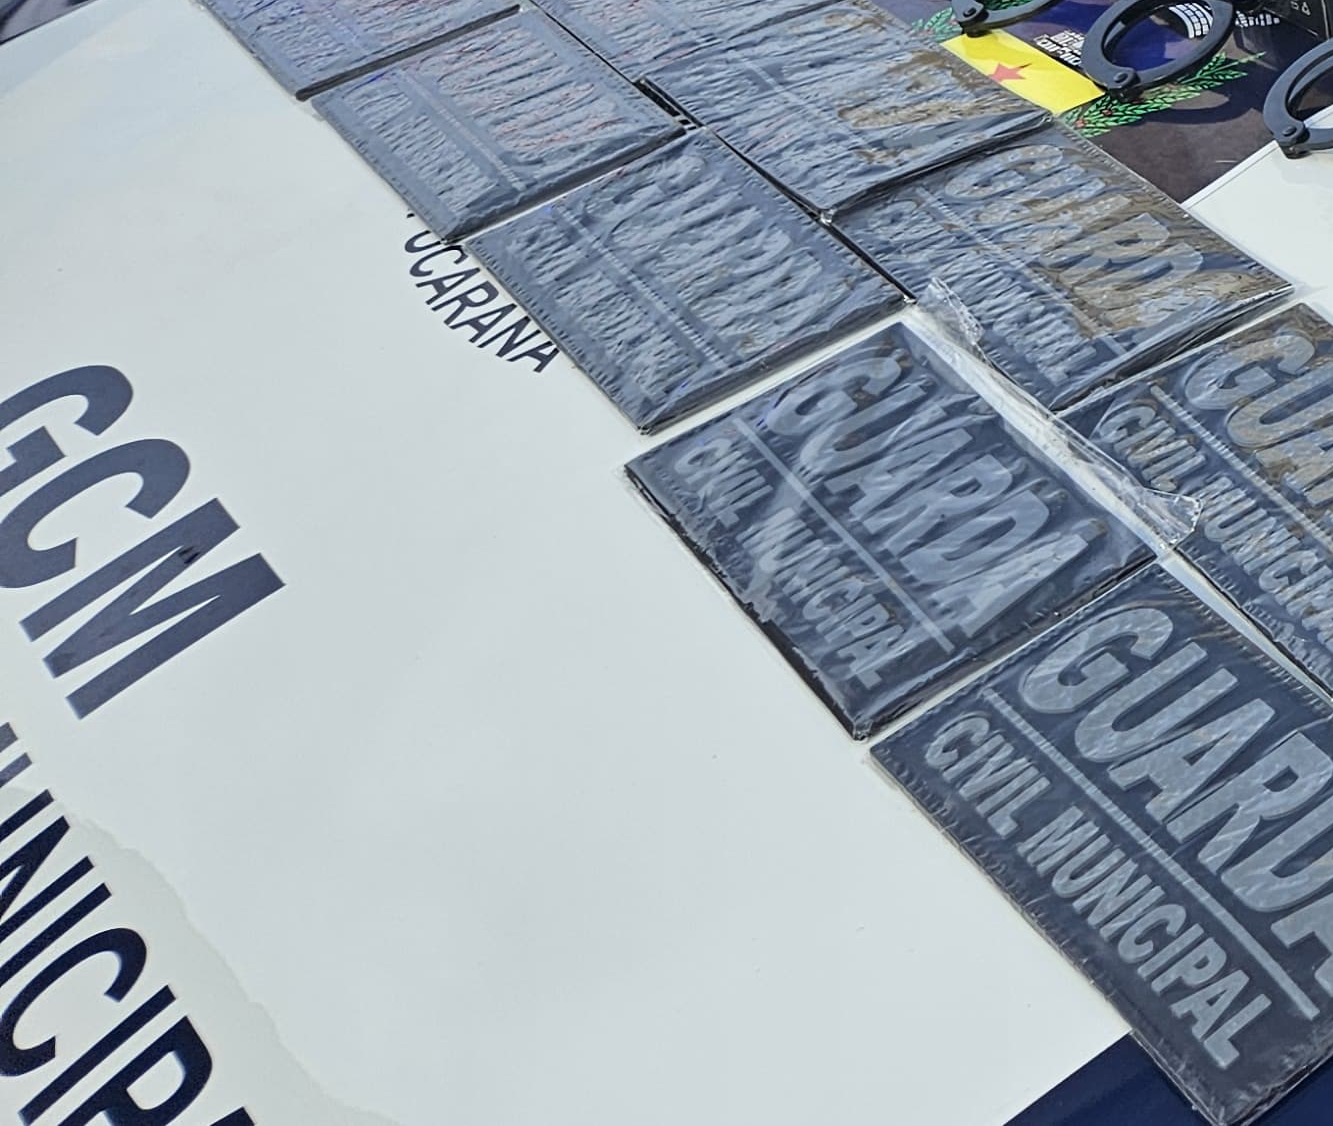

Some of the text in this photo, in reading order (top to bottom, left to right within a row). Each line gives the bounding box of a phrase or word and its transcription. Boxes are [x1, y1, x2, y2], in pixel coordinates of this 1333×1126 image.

[404, 214, 560, 373] UCARANA
[0, 364, 286, 720] GCM
[744, 504, 918, 686] MUNICIPAL
[765, 345, 1109, 637] GUARDA
[924, 714, 1273, 1070] CIVIL MUNICIPAL
